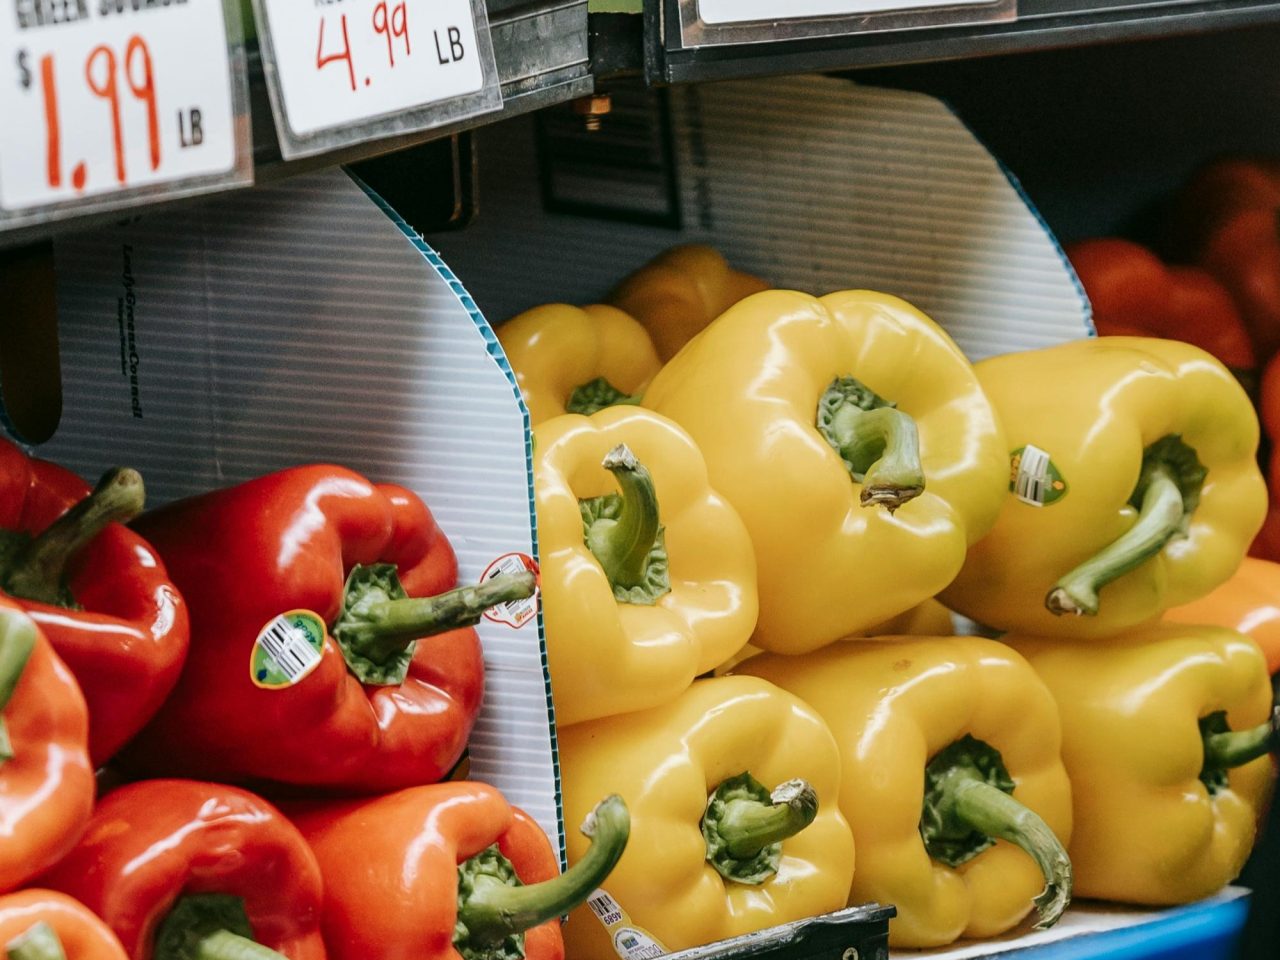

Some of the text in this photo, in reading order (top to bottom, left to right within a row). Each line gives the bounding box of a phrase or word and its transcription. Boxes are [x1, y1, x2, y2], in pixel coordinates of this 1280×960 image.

[316, 0, 465, 92] 4.99 LB
[178, 108, 204, 148] LB
[603, 911, 623, 926] 4689
